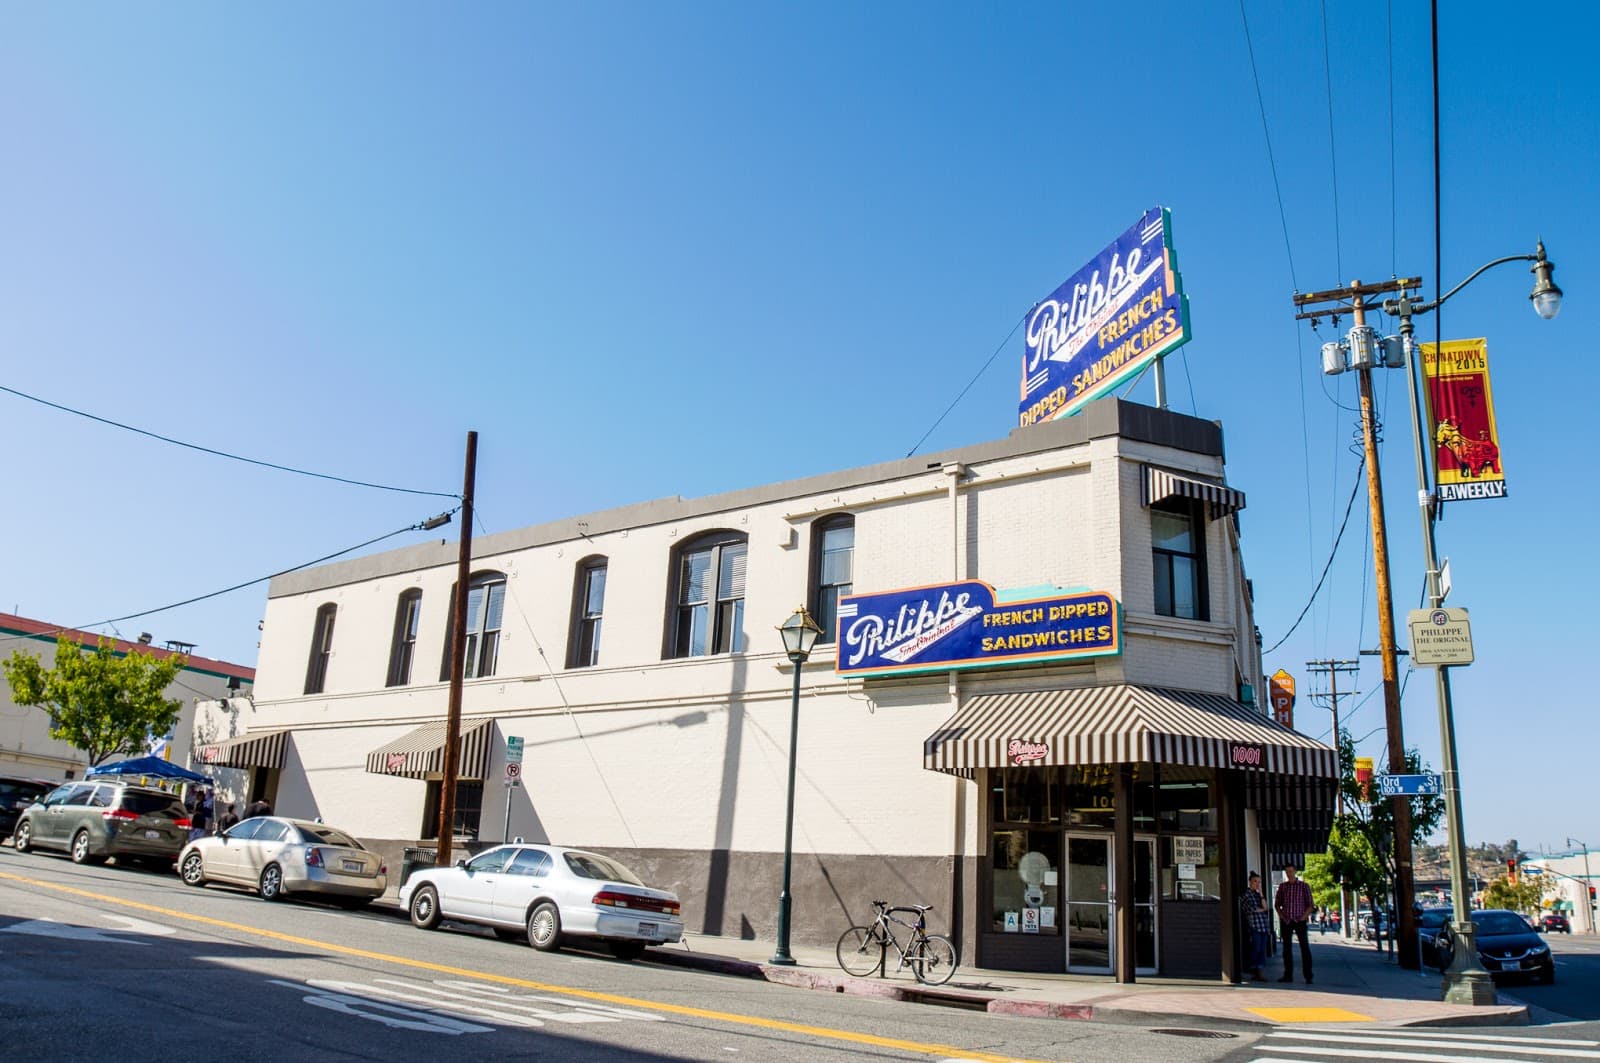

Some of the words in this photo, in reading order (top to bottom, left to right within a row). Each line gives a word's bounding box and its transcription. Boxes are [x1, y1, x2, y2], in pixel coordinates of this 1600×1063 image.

[1027, 248, 1146, 372] Philippe
[1098, 287, 1163, 349] FRENCH
[1424, 348, 1481, 364] CHNATOWN
[1456, 358, 1486, 370] 2015
[1020, 386, 1067, 427] DIPPED
[1073, 309, 1177, 394] SANDWICHES
[983, 607, 1043, 628] FRENCH
[1049, 600, 1109, 620] DIPPED
[846, 590, 974, 666] Philippe
[1420, 627, 1463, 637] PHILIPPE
[981, 626, 1111, 652] SANDWICHES
[1433, 636, 1469, 644] ORIGINAL
[1233, 746, 1260, 765] 1001
[1383, 777, 1400, 788] Ord
[1427, 776, 1438, 787] St
[1008, 916, 1016, 926] A
